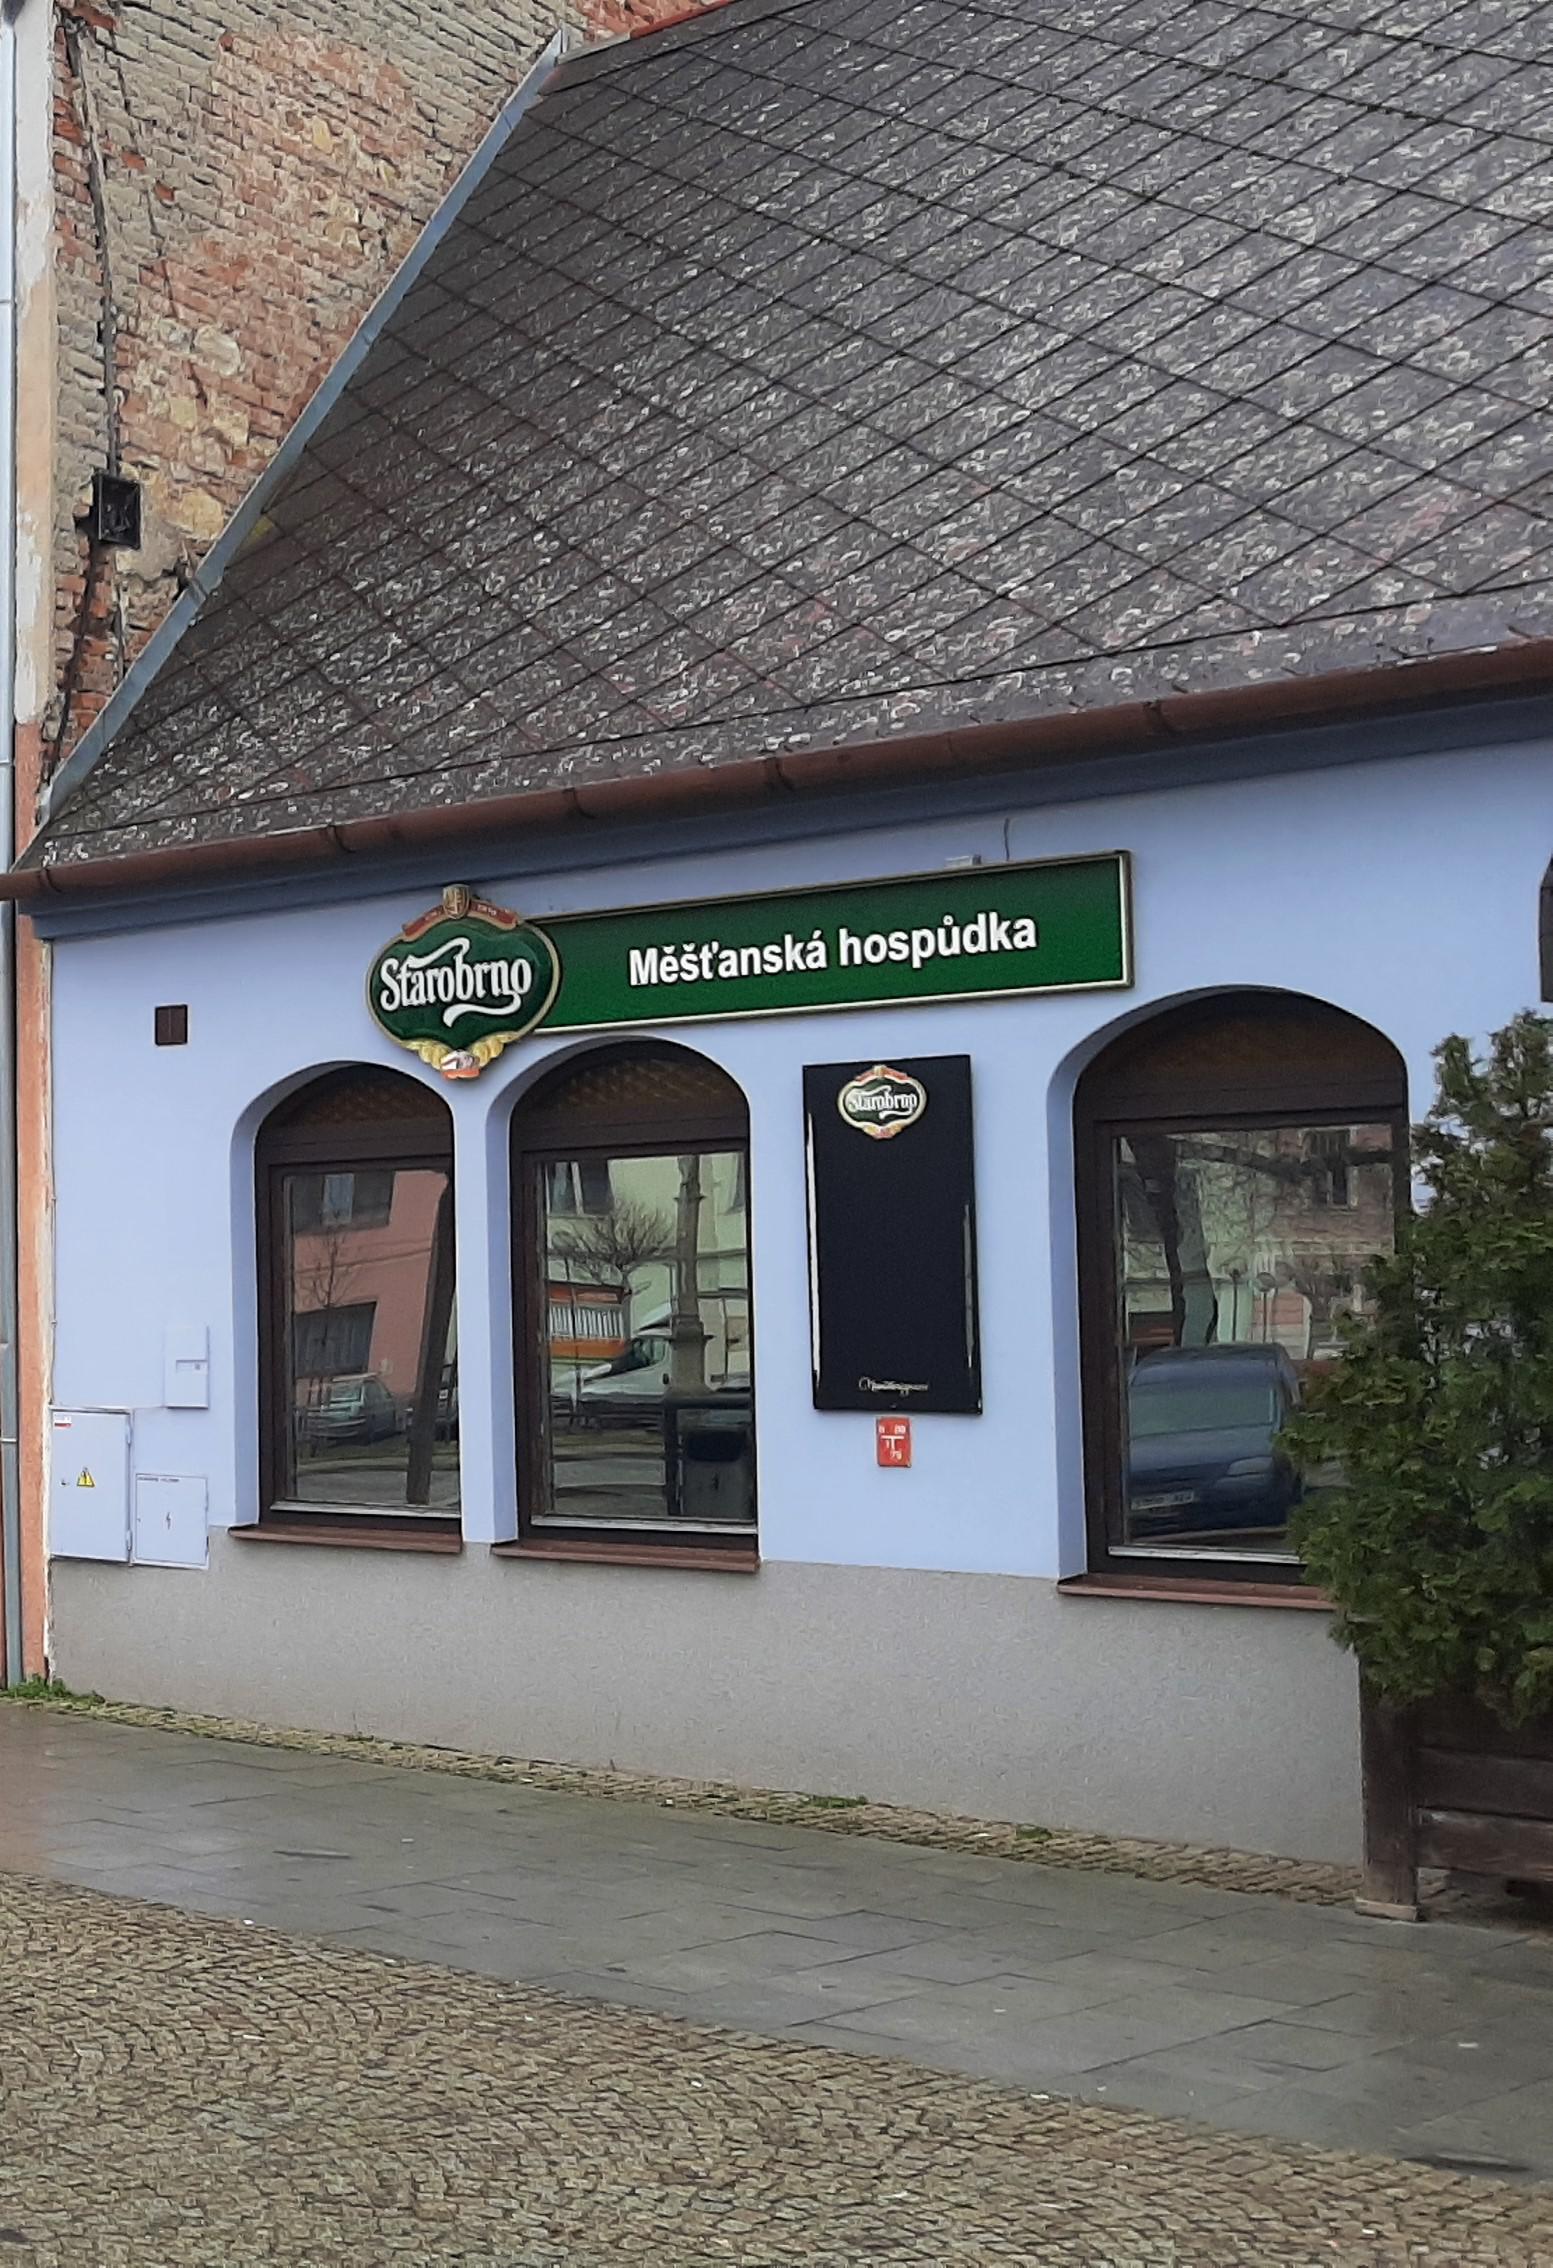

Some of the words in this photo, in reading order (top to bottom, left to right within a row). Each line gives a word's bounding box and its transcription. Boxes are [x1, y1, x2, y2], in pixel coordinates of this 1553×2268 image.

[380, 937, 532, 1028] Starobrno
[629, 930, 827, 986] Měšťanská
[838, 911, 1037, 968] hospůdka
